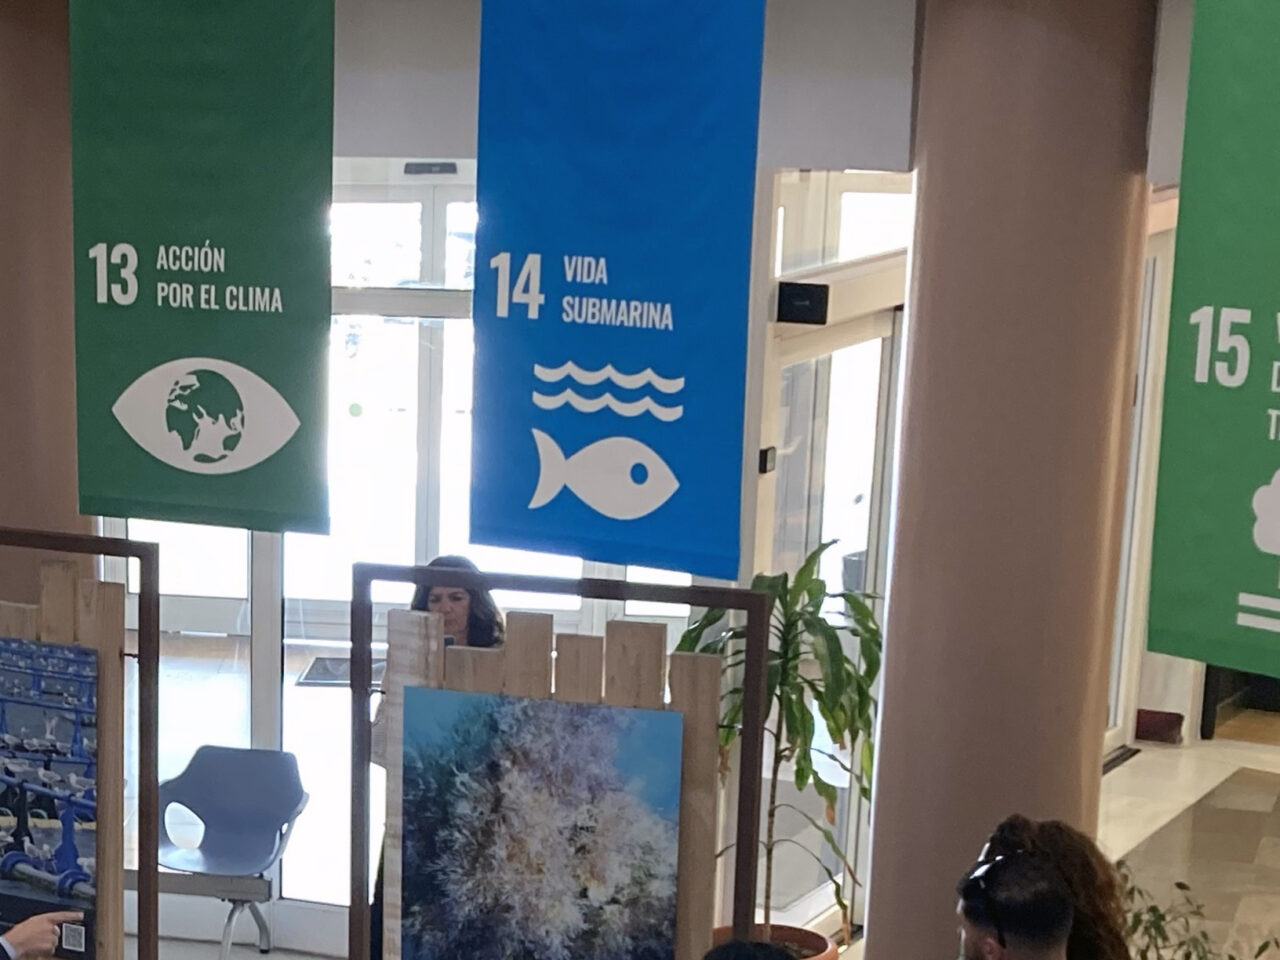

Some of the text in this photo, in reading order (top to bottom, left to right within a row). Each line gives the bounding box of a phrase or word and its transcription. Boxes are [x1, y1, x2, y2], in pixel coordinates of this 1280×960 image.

[157, 240, 224, 272] ACCIÓN
[564, 256, 607, 284] VIDA
[89, 243, 138, 305] 13
[490, 252, 544, 319] 14
[158, 283, 282, 312] POR EL CLIMA
[562, 296, 673, 330] SUBMARINA
[1190, 306, 1251, 387] 15
